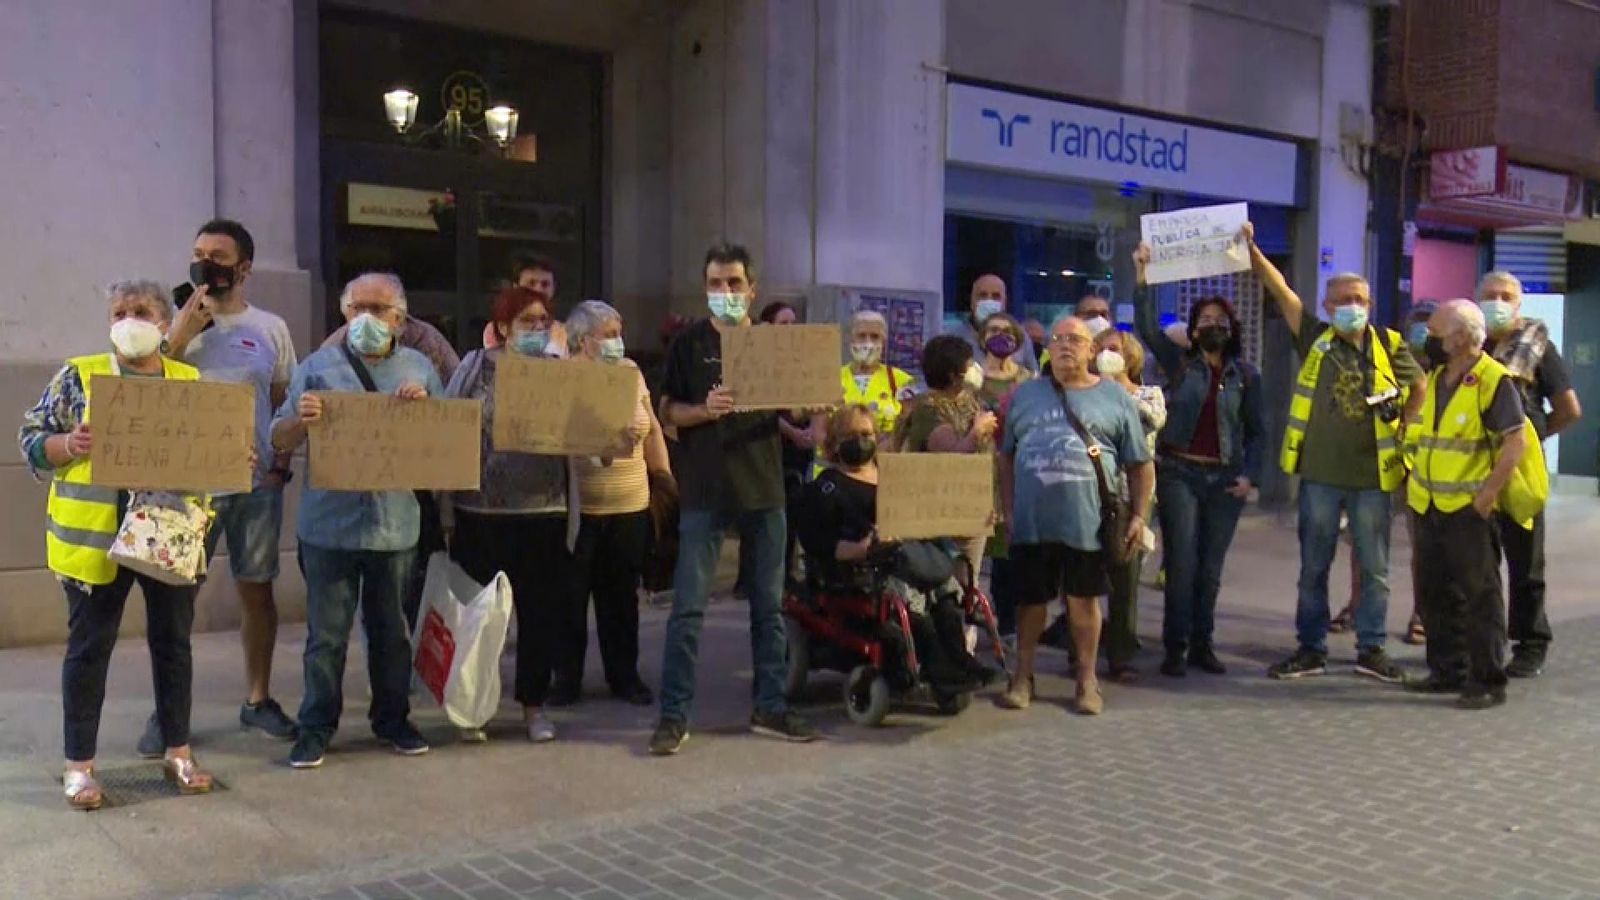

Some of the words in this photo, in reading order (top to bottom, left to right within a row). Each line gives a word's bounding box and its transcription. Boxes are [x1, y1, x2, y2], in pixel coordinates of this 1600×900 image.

[451, 85, 482, 114] 95
[1050, 117, 1188, 173] randstad
[106, 413, 208, 440] LEGAL
[102, 443, 171, 470] PLENA
[184, 443, 243, 473] LUZ
